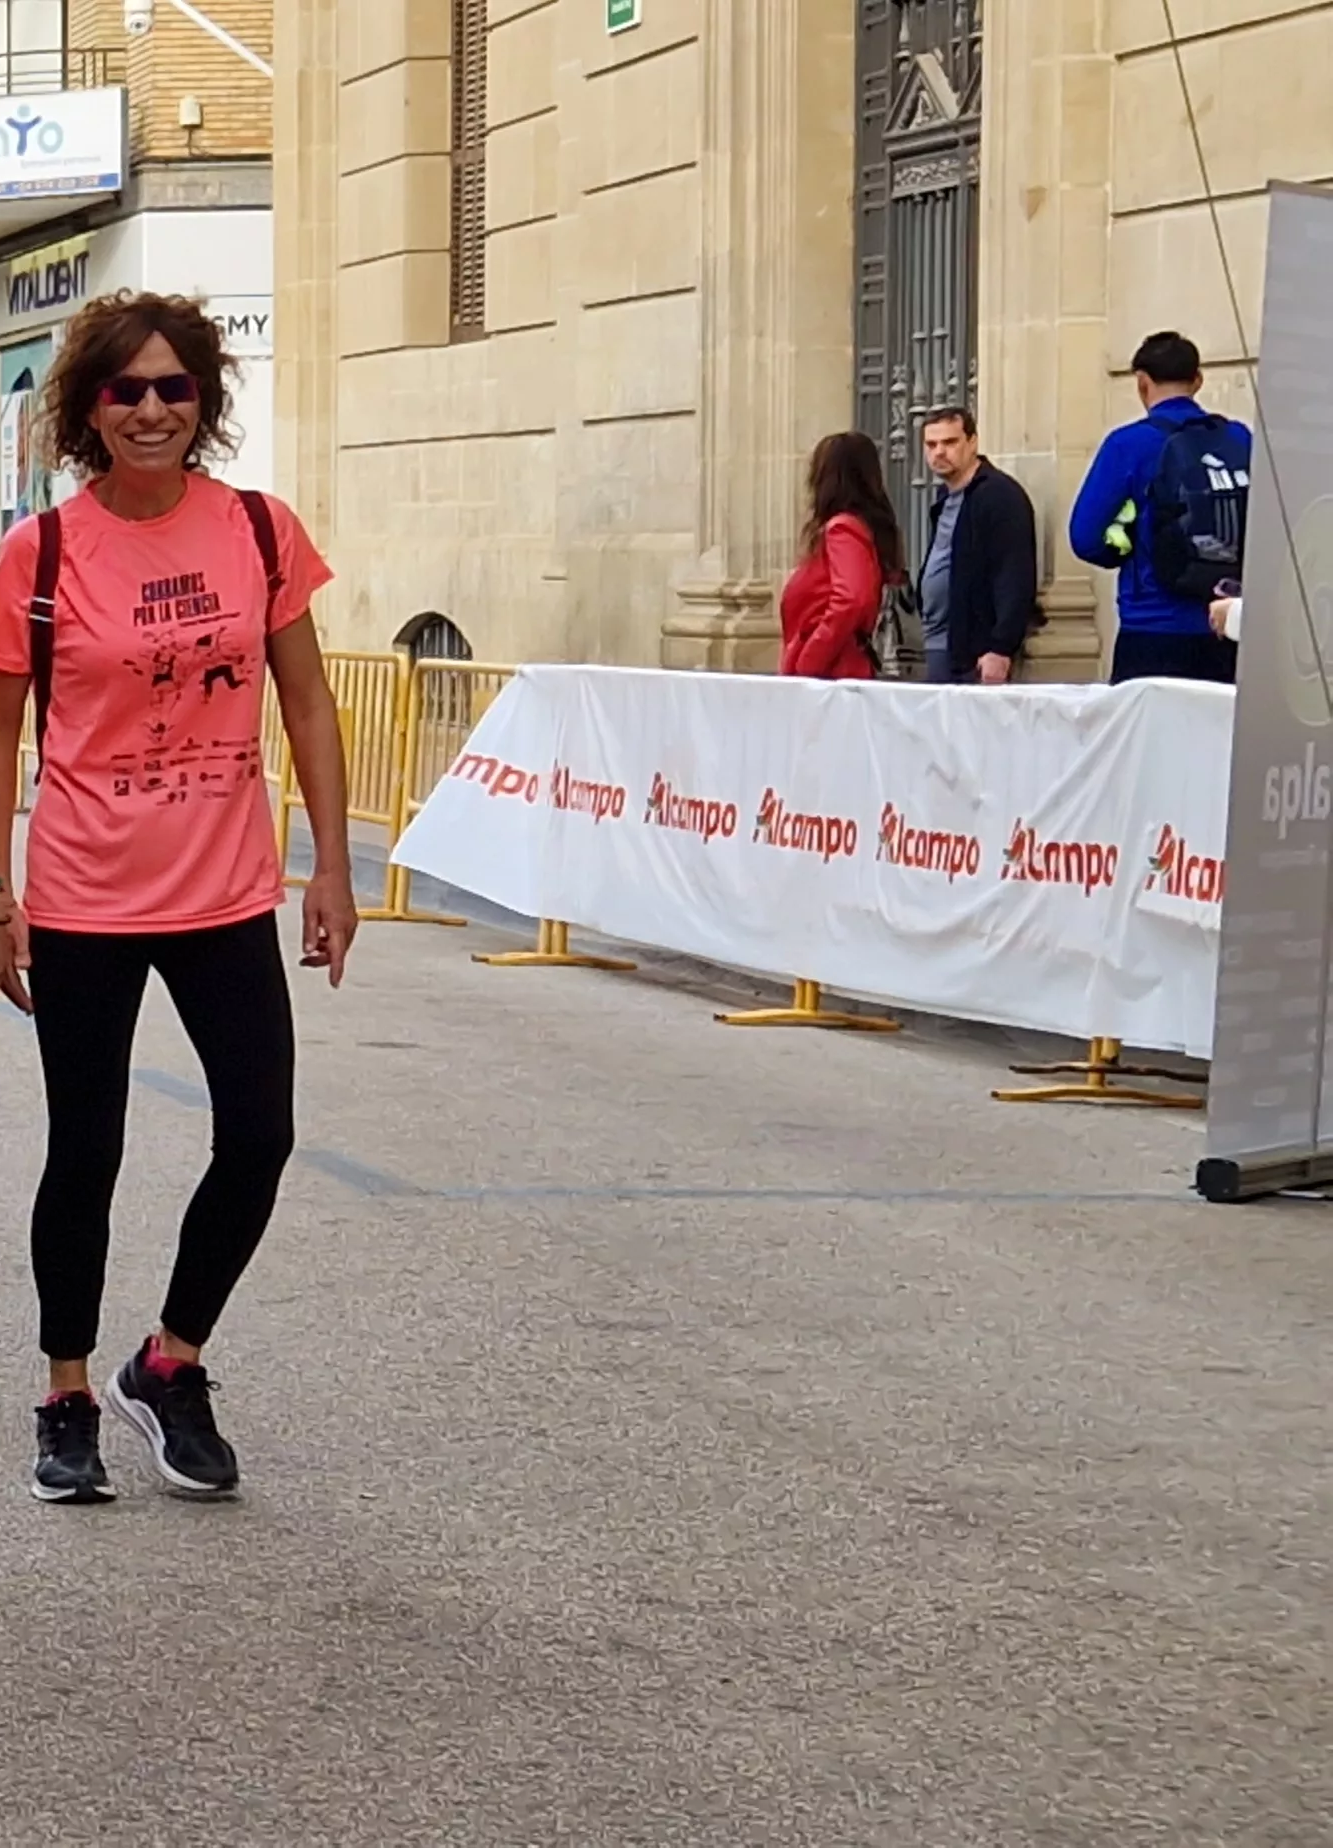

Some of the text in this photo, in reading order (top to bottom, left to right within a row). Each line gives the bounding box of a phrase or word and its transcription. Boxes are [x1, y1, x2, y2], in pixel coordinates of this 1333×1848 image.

[549, 758, 626, 825] Alcampo
[644, 772, 737, 844] Alcampo
[752, 787, 857, 864] Alcampo
[876, 801, 980, 885] Alcampo
[1145, 823, 1226, 904] Alca
